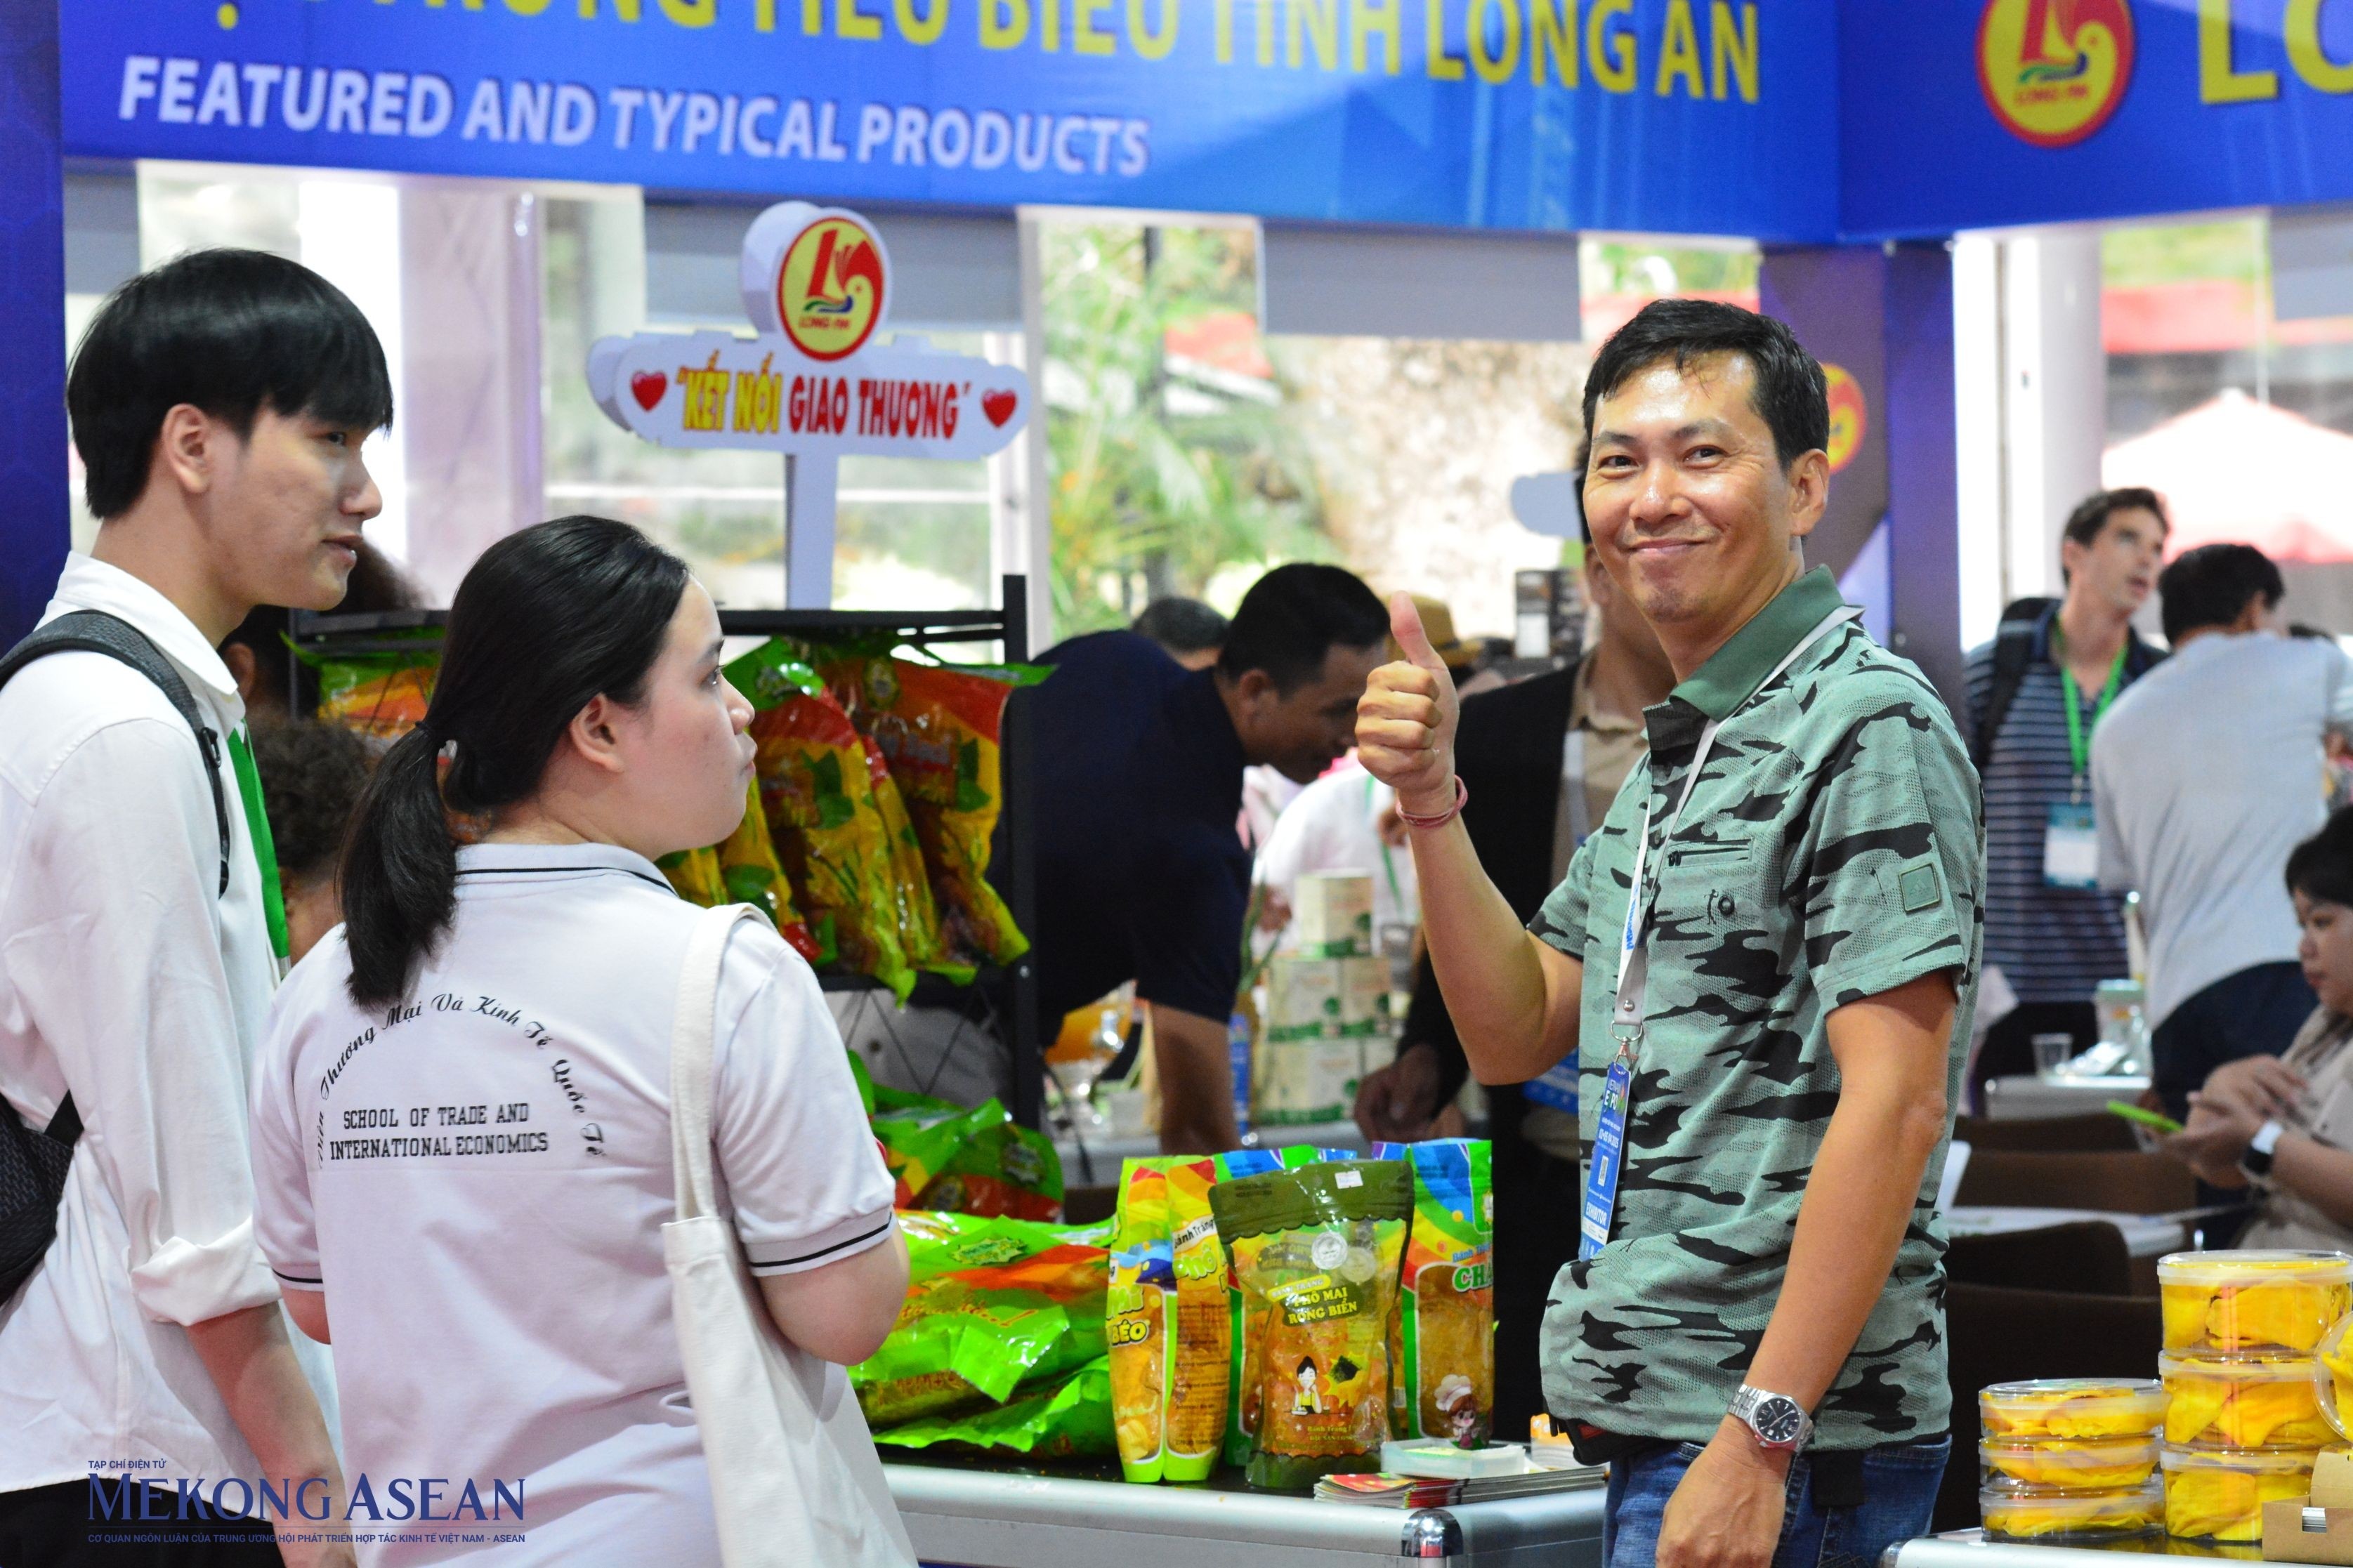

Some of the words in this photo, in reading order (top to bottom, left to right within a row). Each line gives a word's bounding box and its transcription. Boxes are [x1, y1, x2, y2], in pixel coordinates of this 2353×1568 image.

[1427, 0, 1638, 93] LONG
[1654, 1, 1759, 103] AN
[119, 55, 453, 138] FEATURED
[461, 79, 598, 147] AND
[609, 88, 846, 162] TYPICAL
[858, 104, 1150, 177] PRODUCTS
[788, 374, 849, 435] GIAO
[469, 996, 523, 1027] Kinh
[343, 1108, 399, 1130] SCHOOL
[409, 1107, 430, 1128] OF
[437, 1105, 487, 1126] TRADE
[494, 1102, 530, 1124] AND
[329, 1135, 452, 1161] INTERNATIONAL
[455, 1131, 549, 1156] ECONOMICS
[1322, 1286, 1348, 1301] MAI
